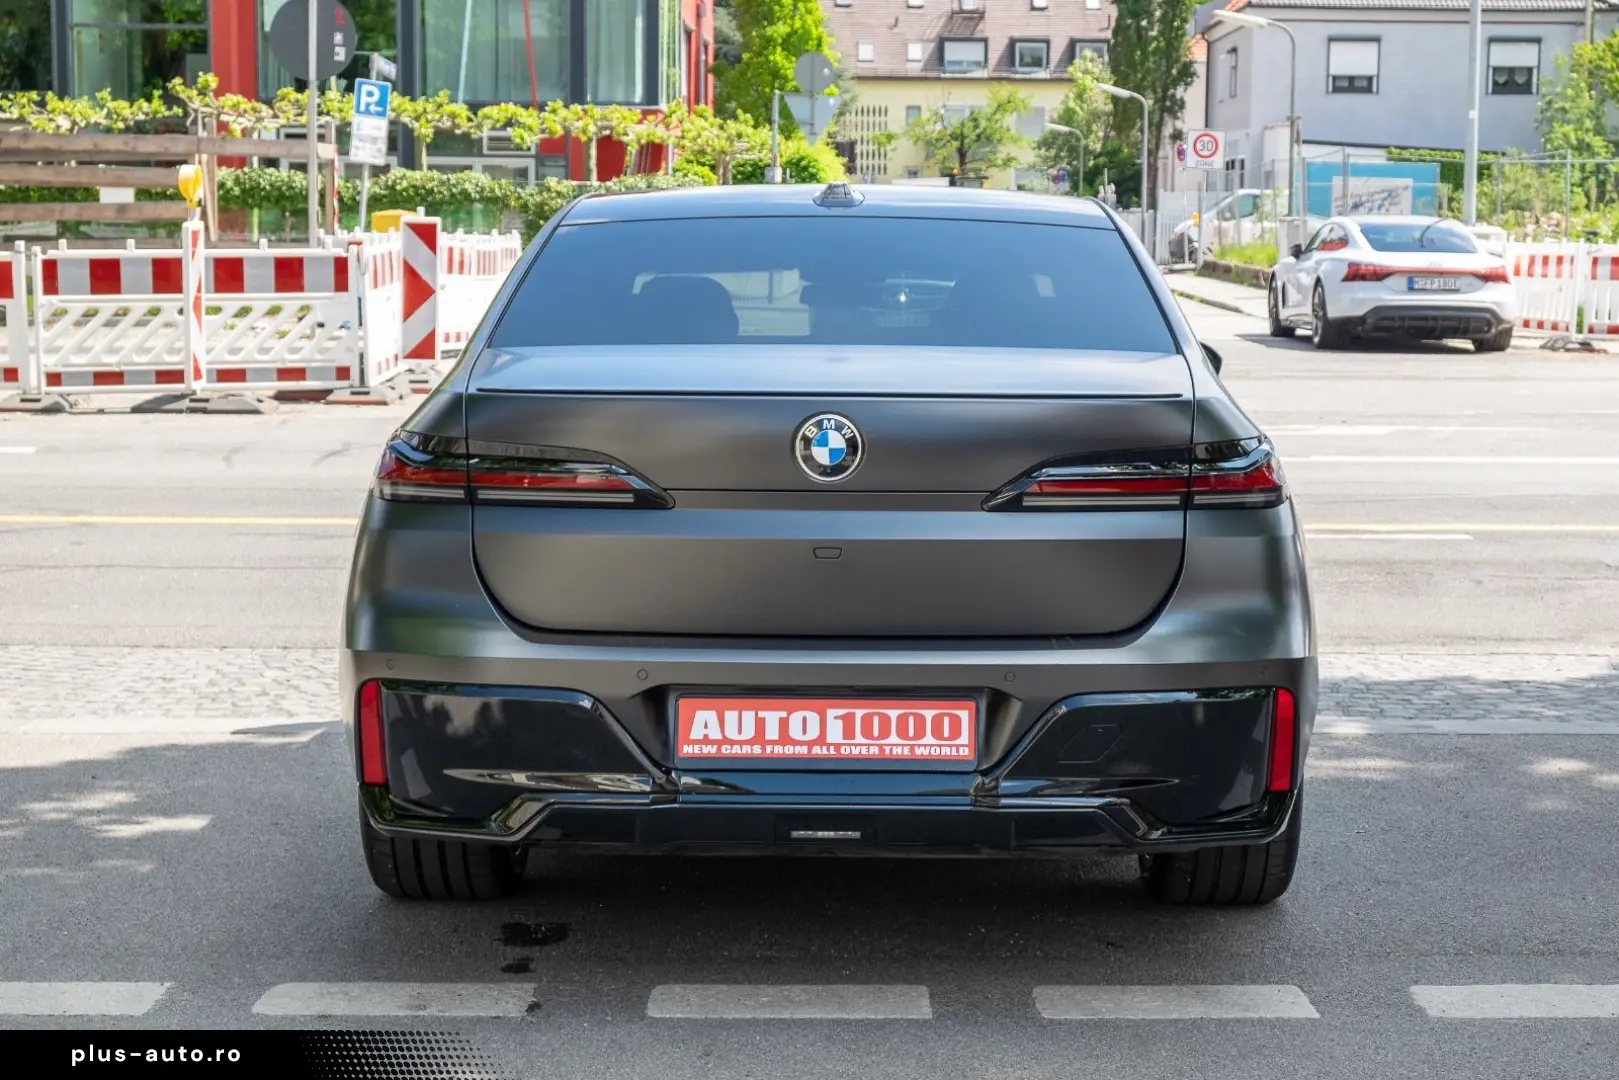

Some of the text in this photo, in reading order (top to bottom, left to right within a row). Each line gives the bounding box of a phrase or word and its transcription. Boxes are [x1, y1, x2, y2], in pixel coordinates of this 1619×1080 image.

[359, 83, 381, 113] P
[1198, 139, 1214, 152] 30
[804, 418, 855, 440] BMW
[688, 709, 963, 742] AUTO 1000
[682, 744, 969, 756] NEW CARS FROM ALL OVER THE WORLD
